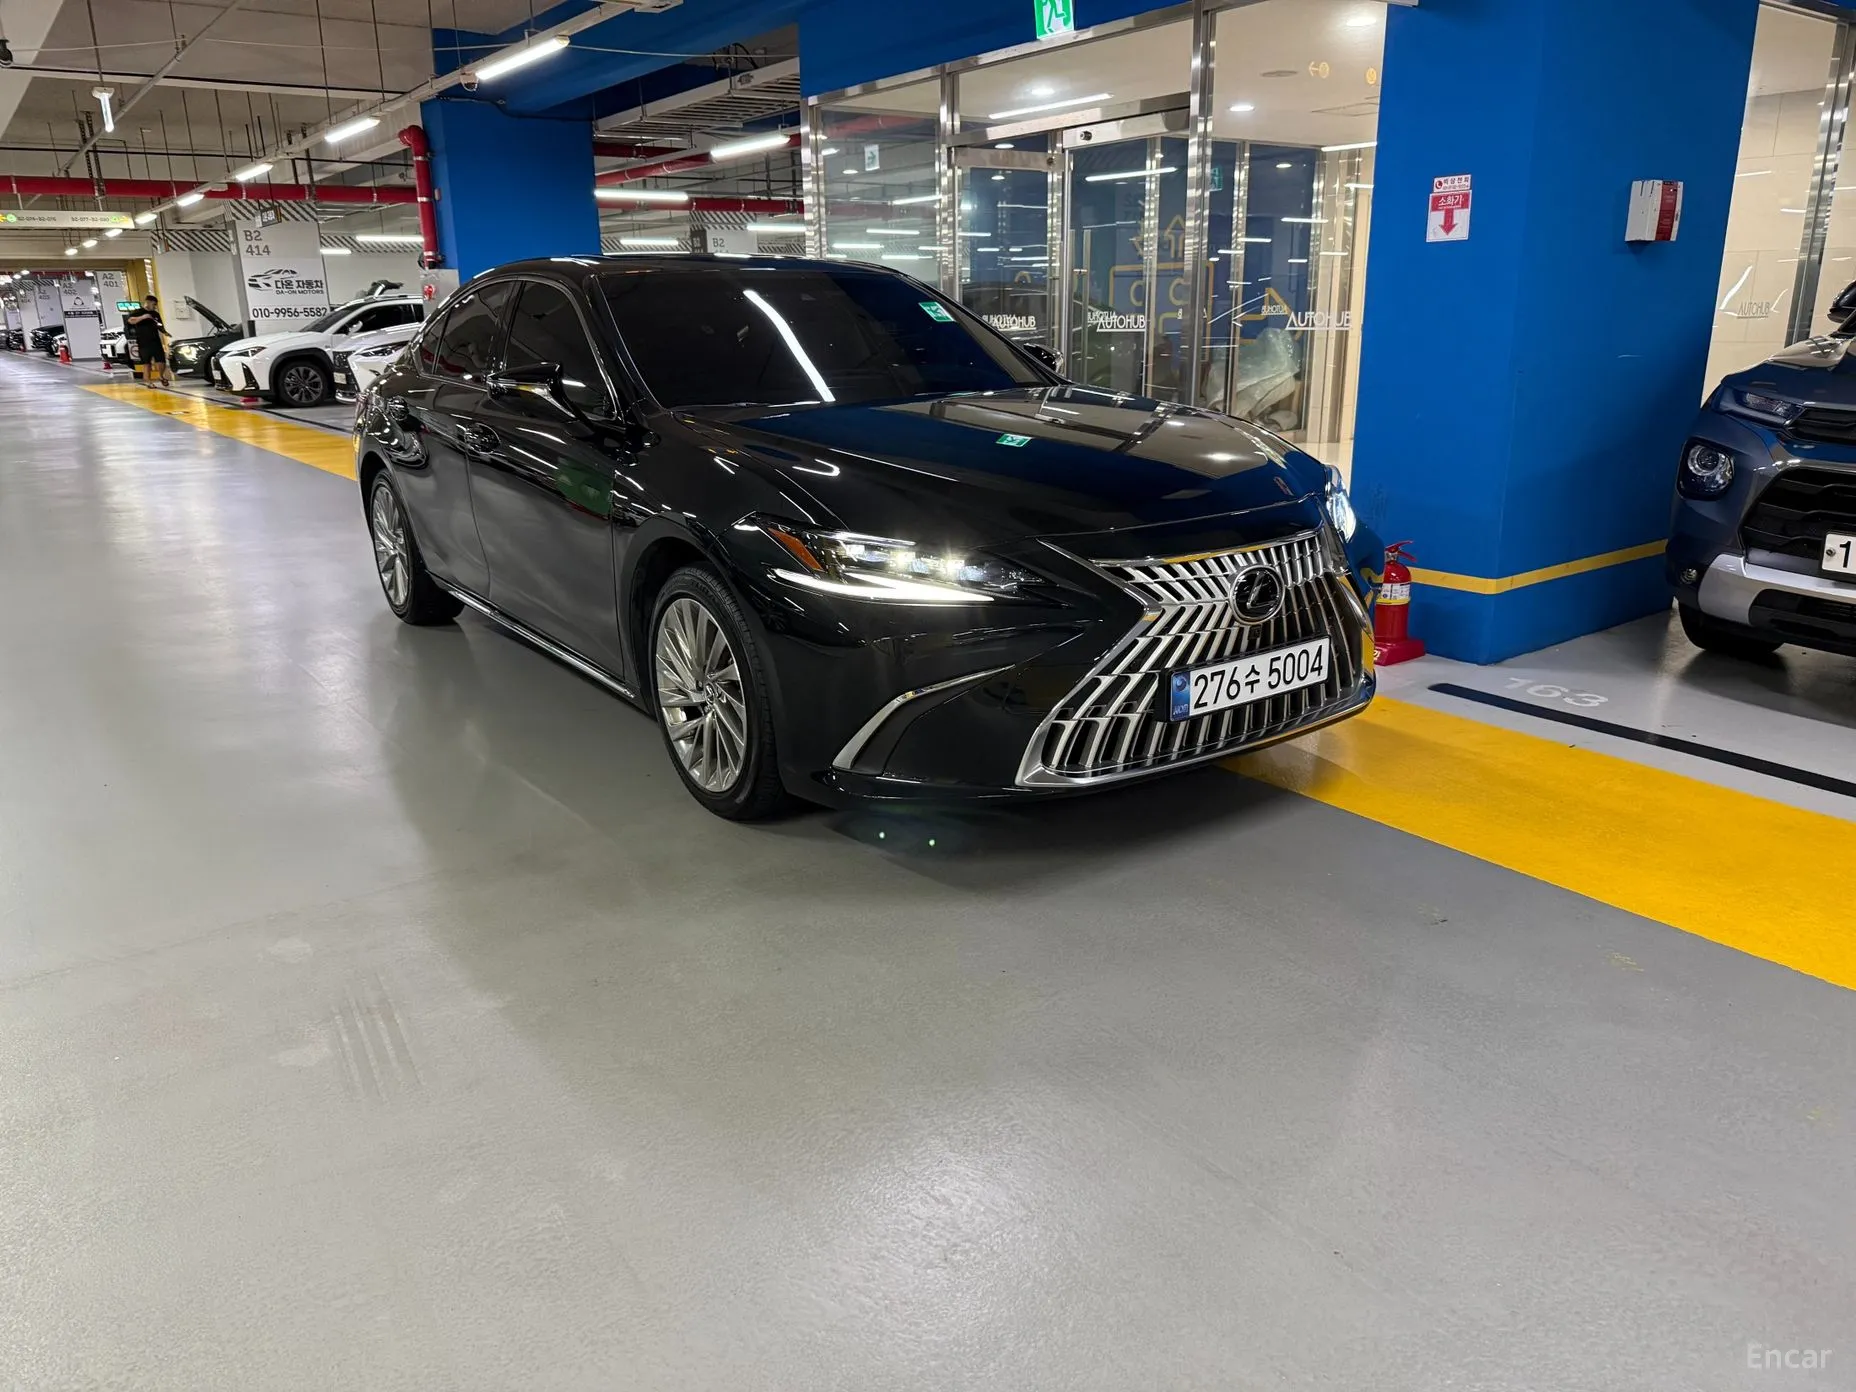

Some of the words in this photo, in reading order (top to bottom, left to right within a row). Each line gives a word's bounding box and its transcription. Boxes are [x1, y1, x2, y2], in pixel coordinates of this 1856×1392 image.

[1438, 195, 1462, 206] 소화기
[244, 230, 262, 241] B2
[713, 238, 725, 247] B2
[246, 245, 271, 256] 414
[275, 280, 294, 289] 다온
[296, 280, 324, 289] 자동차
[252, 307, 328, 318] 010-9956-5582
[1737, 301, 1770, 316] AUTOHUB
[1098, 315, 1146, 329] AUTOHUB
[1286, 311, 1352, 329] AUTOHUB
[1839, 541, 1851, 568] 1
[1194, 664, 1260, 709] 276수
[1268, 645, 1323, 689] 5004
[1504, 677, 1609, 707] 163
